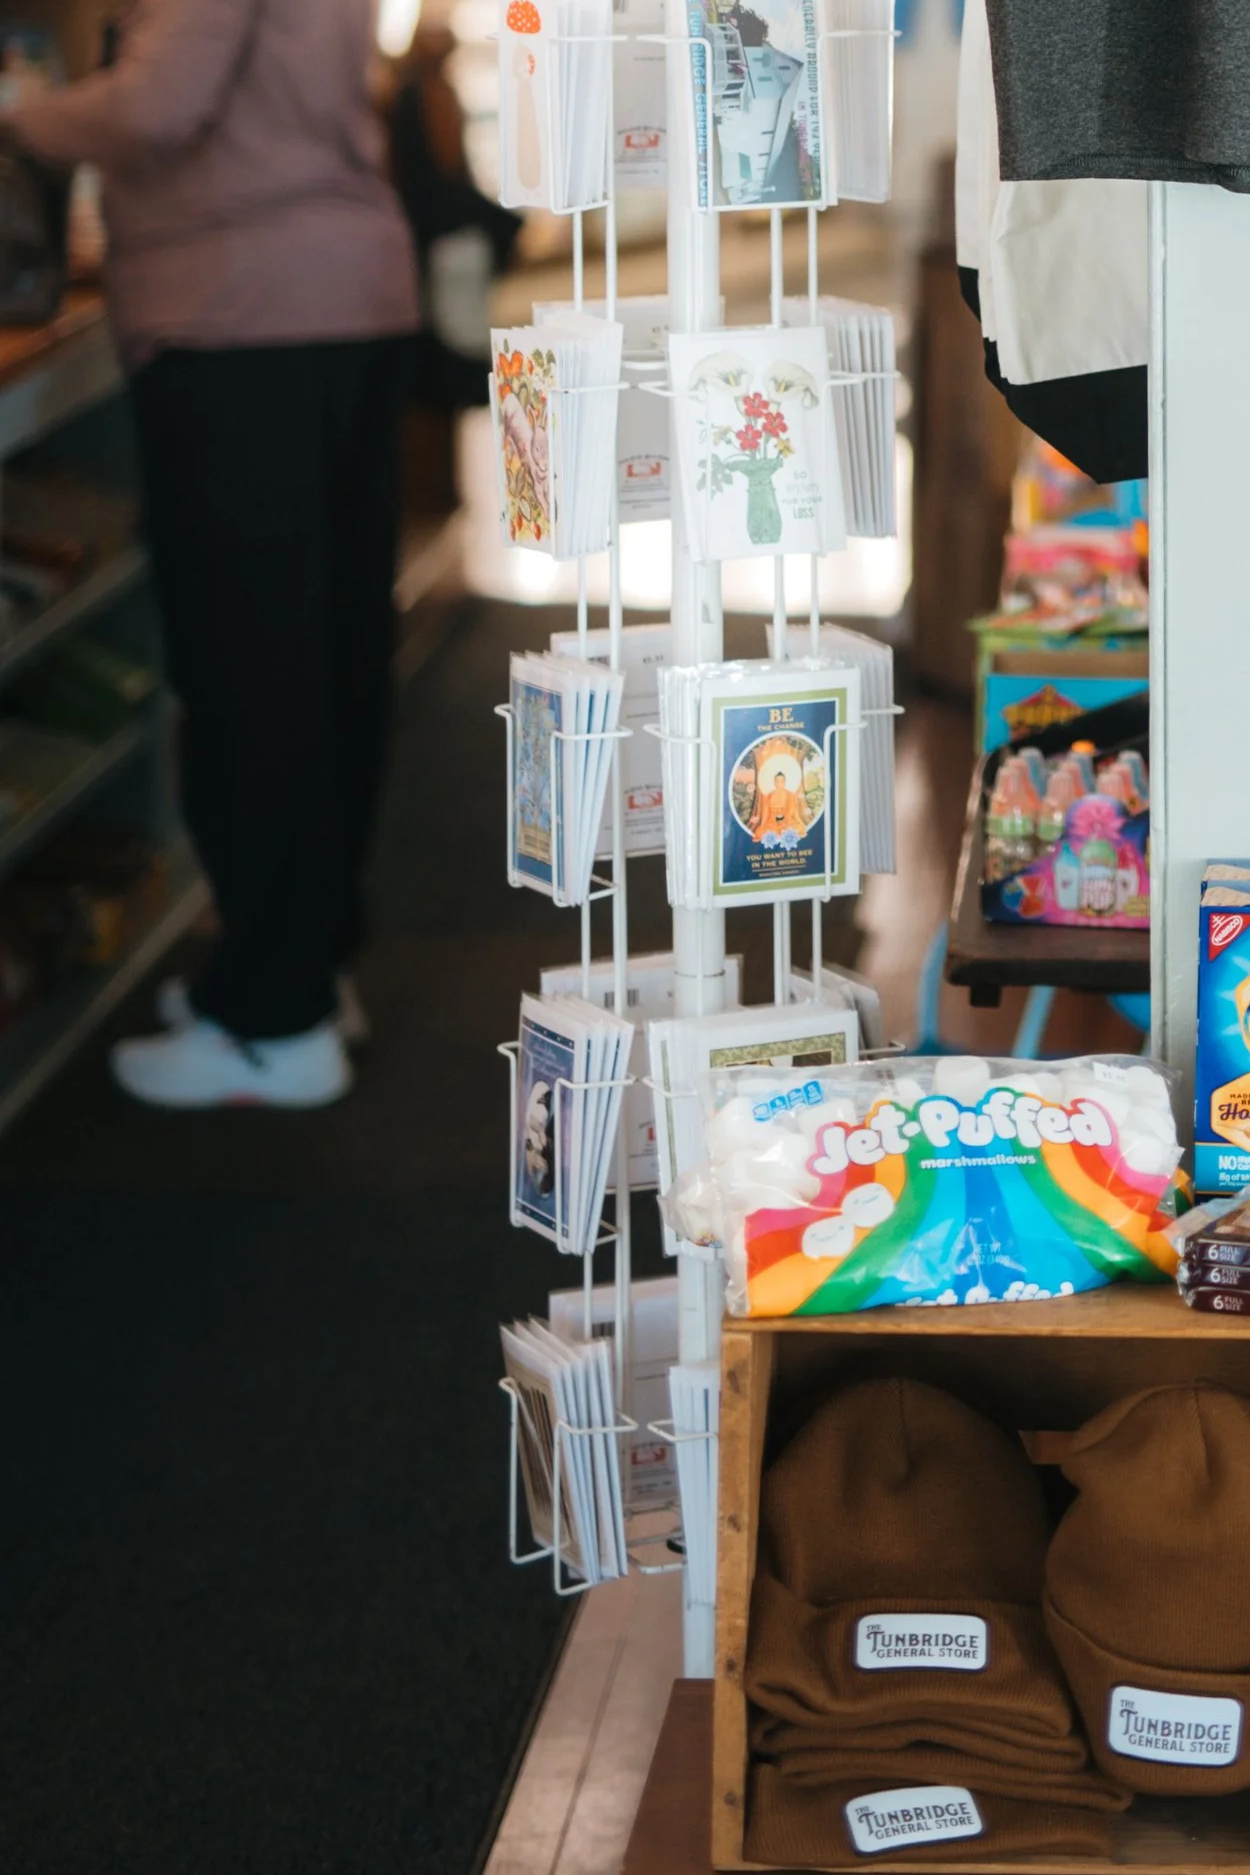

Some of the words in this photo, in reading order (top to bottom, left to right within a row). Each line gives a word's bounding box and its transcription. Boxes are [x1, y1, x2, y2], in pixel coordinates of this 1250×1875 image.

[690, 9, 706, 85] TUNRIDGE
[769, 707, 794, 724] BE
[763, 852, 785, 860] WANT
[811, 1089, 1114, 1175] Jet-Puffed
[919, 1153, 1037, 1170] marshmallows
[1218, 1155, 1237, 1170] NO
[1208, 1244, 1219, 1260] 6
[1219, 1245, 1239, 1255] FULL
[1219, 1253, 1236, 1262] SIZE
[1210, 1267, 1221, 1283] 6
[1221, 1268, 1241, 1278] FULL
[1221, 1276, 1239, 1285] SIZE
[1213, 1294, 1224, 1310] 6
[1224, 1296, 1244, 1305] FULL
[1224, 1303, 1242, 1311] SIZE
[866, 1624, 882, 1632] THE
[866, 1630, 979, 1654] TUNBRIDGE
[876, 1647, 935, 1659] GENERAL
[938, 1647, 979, 1659] STORE
[1120, 1699, 1135, 1709] THE
[1119, 1708, 1232, 1741] TUNBRIDGE
[1128, 1733, 1185, 1752] GENERAL
[1189, 1741, 1231, 1754] STORE
[854, 1805, 871, 1816] THE
[858, 1802, 971, 1836] TUNBRIDGE
[875, 1822, 933, 1840] GENERAL
[935, 1816, 975, 1830] STORE
